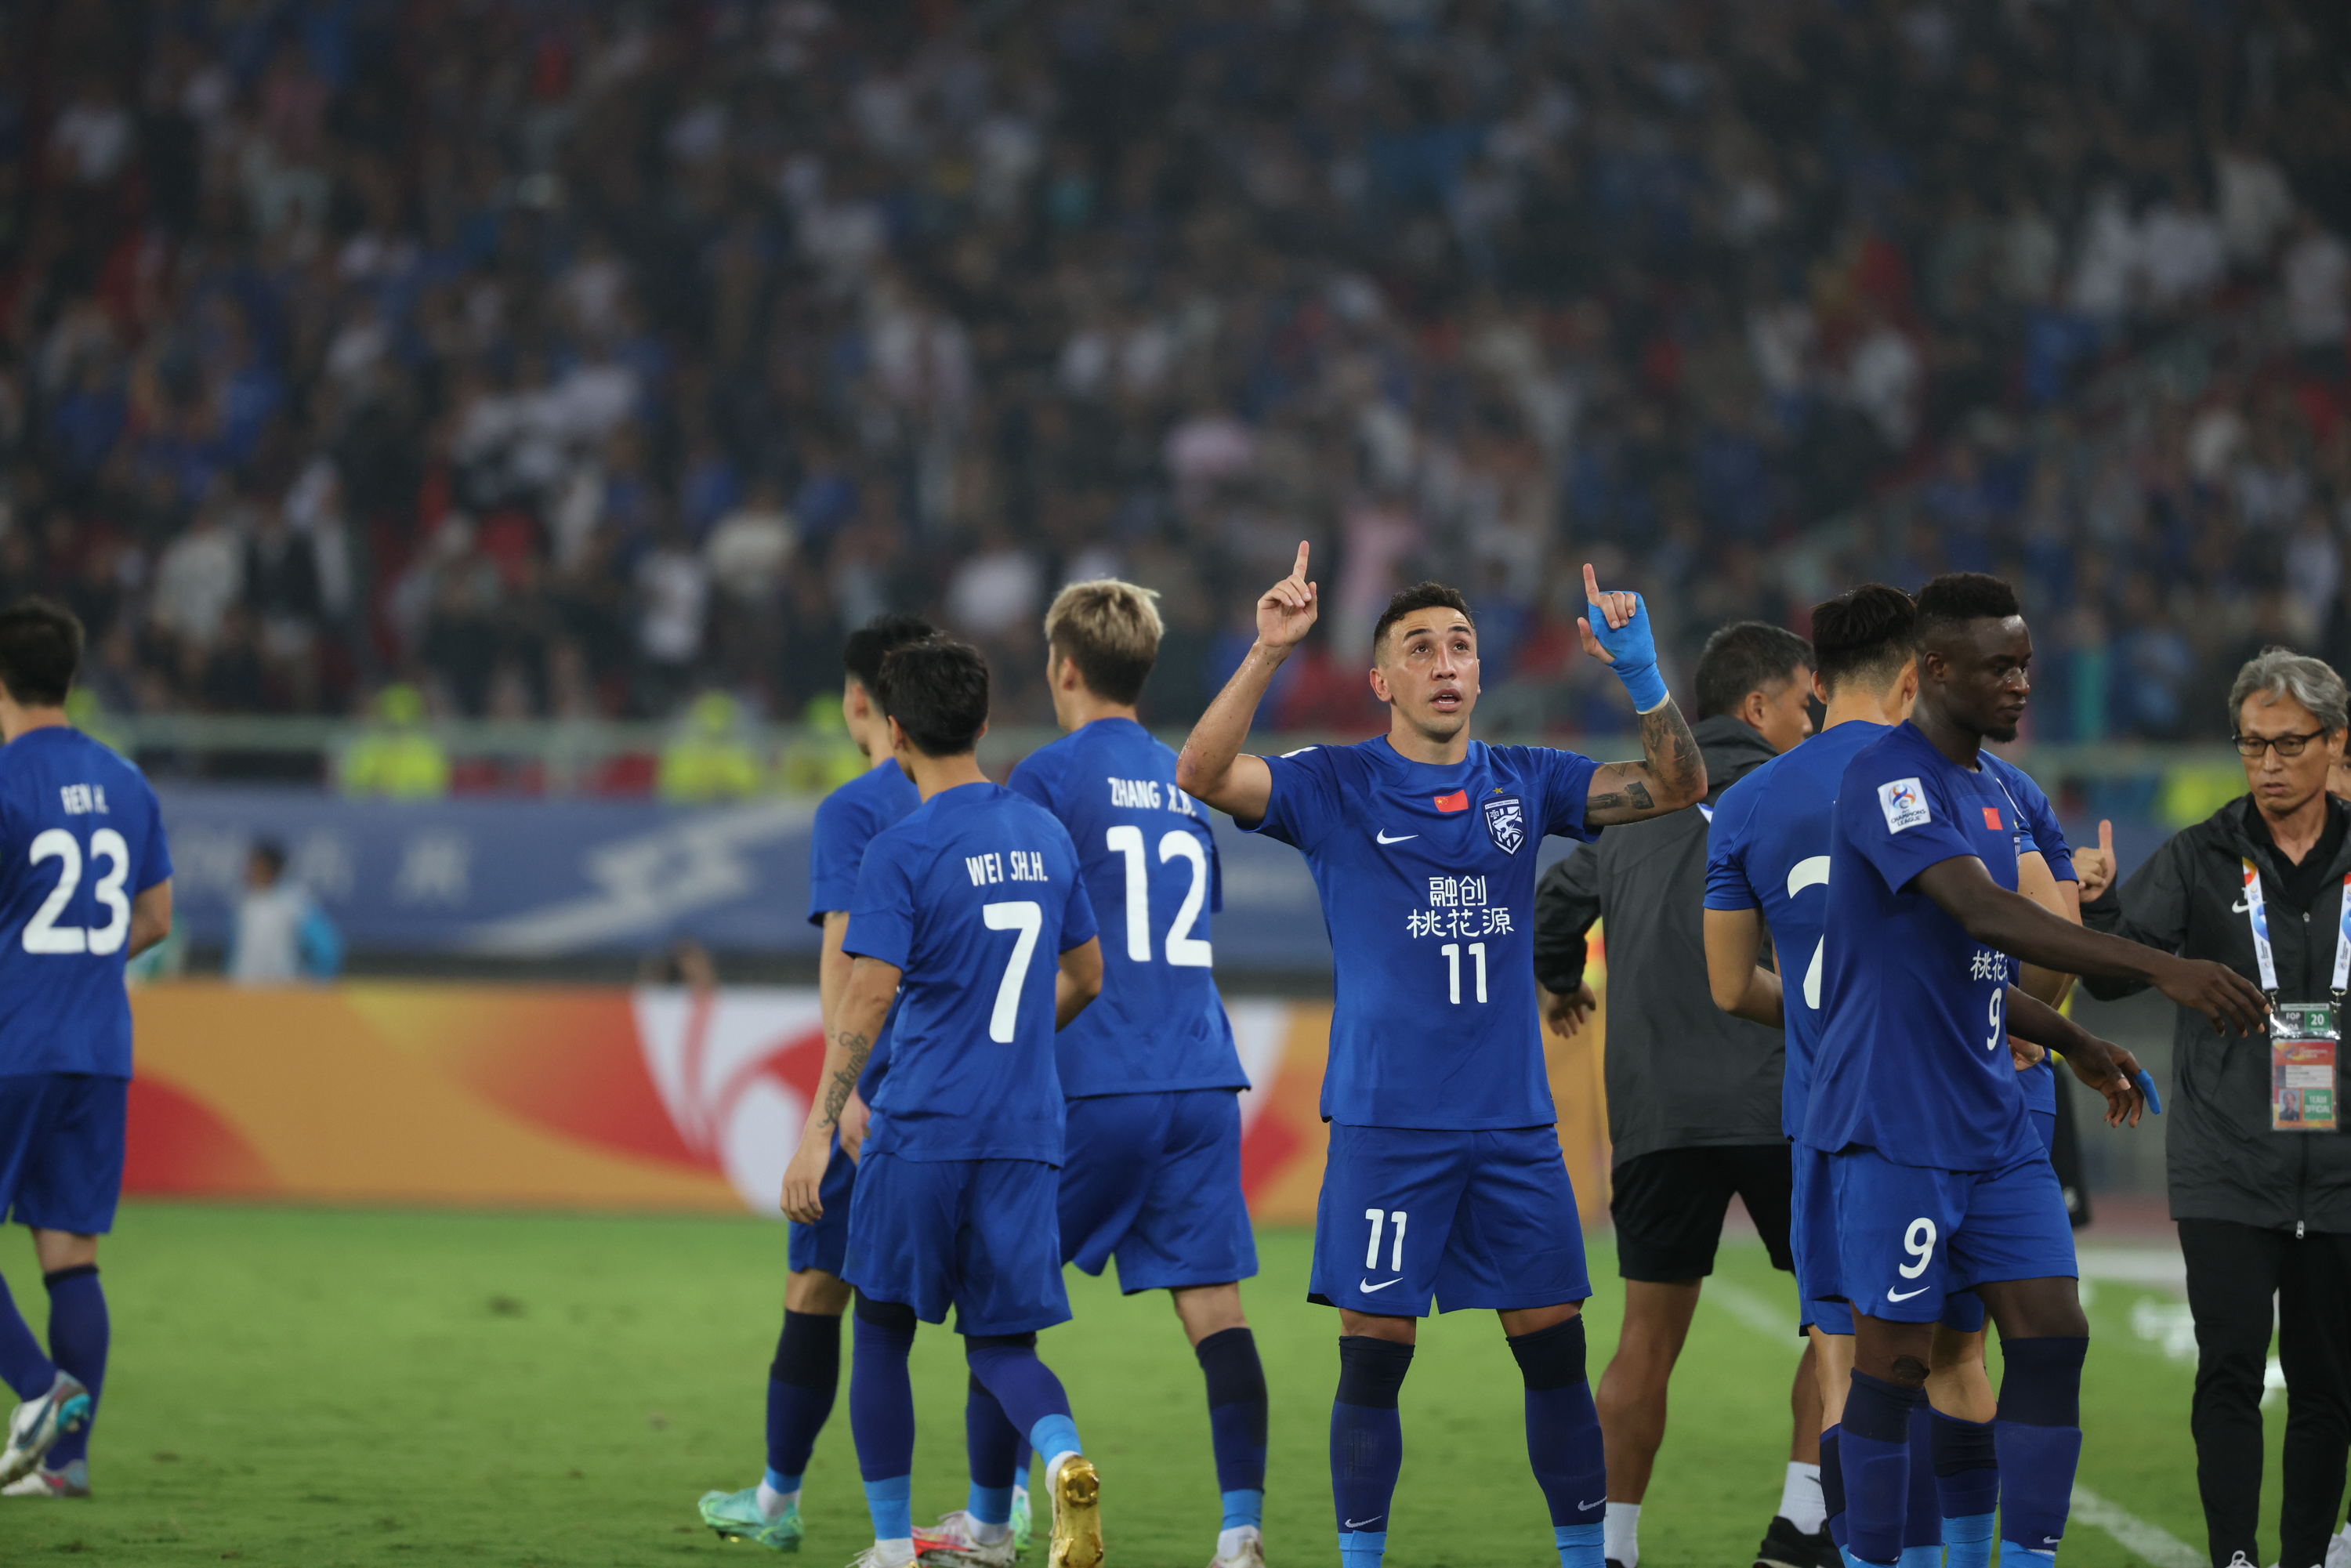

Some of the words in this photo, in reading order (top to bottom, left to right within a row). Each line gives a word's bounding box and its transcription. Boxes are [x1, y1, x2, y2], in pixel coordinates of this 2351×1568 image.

[1107, 777, 1161, 809] ZHANG
[22, 827, 131, 955] 23
[965, 852, 1003, 886] WEI
[1010, 850, 1049, 882] SH.H.
[1107, 825, 1213, 968] 12
[1429, 875, 1487, 907] 融创
[1406, 907, 1515, 939] 桃花源
[983, 900, 1042, 1043] 7
[1441, 942, 1487, 1005] 11
[1970, 950, 2008, 982] 桃花
[1987, 987, 2002, 1051] 9
[2310, 1013, 2325, 1026] 20
[1365, 1208, 1407, 1272] 11
[1899, 1217, 1936, 1279] 9
